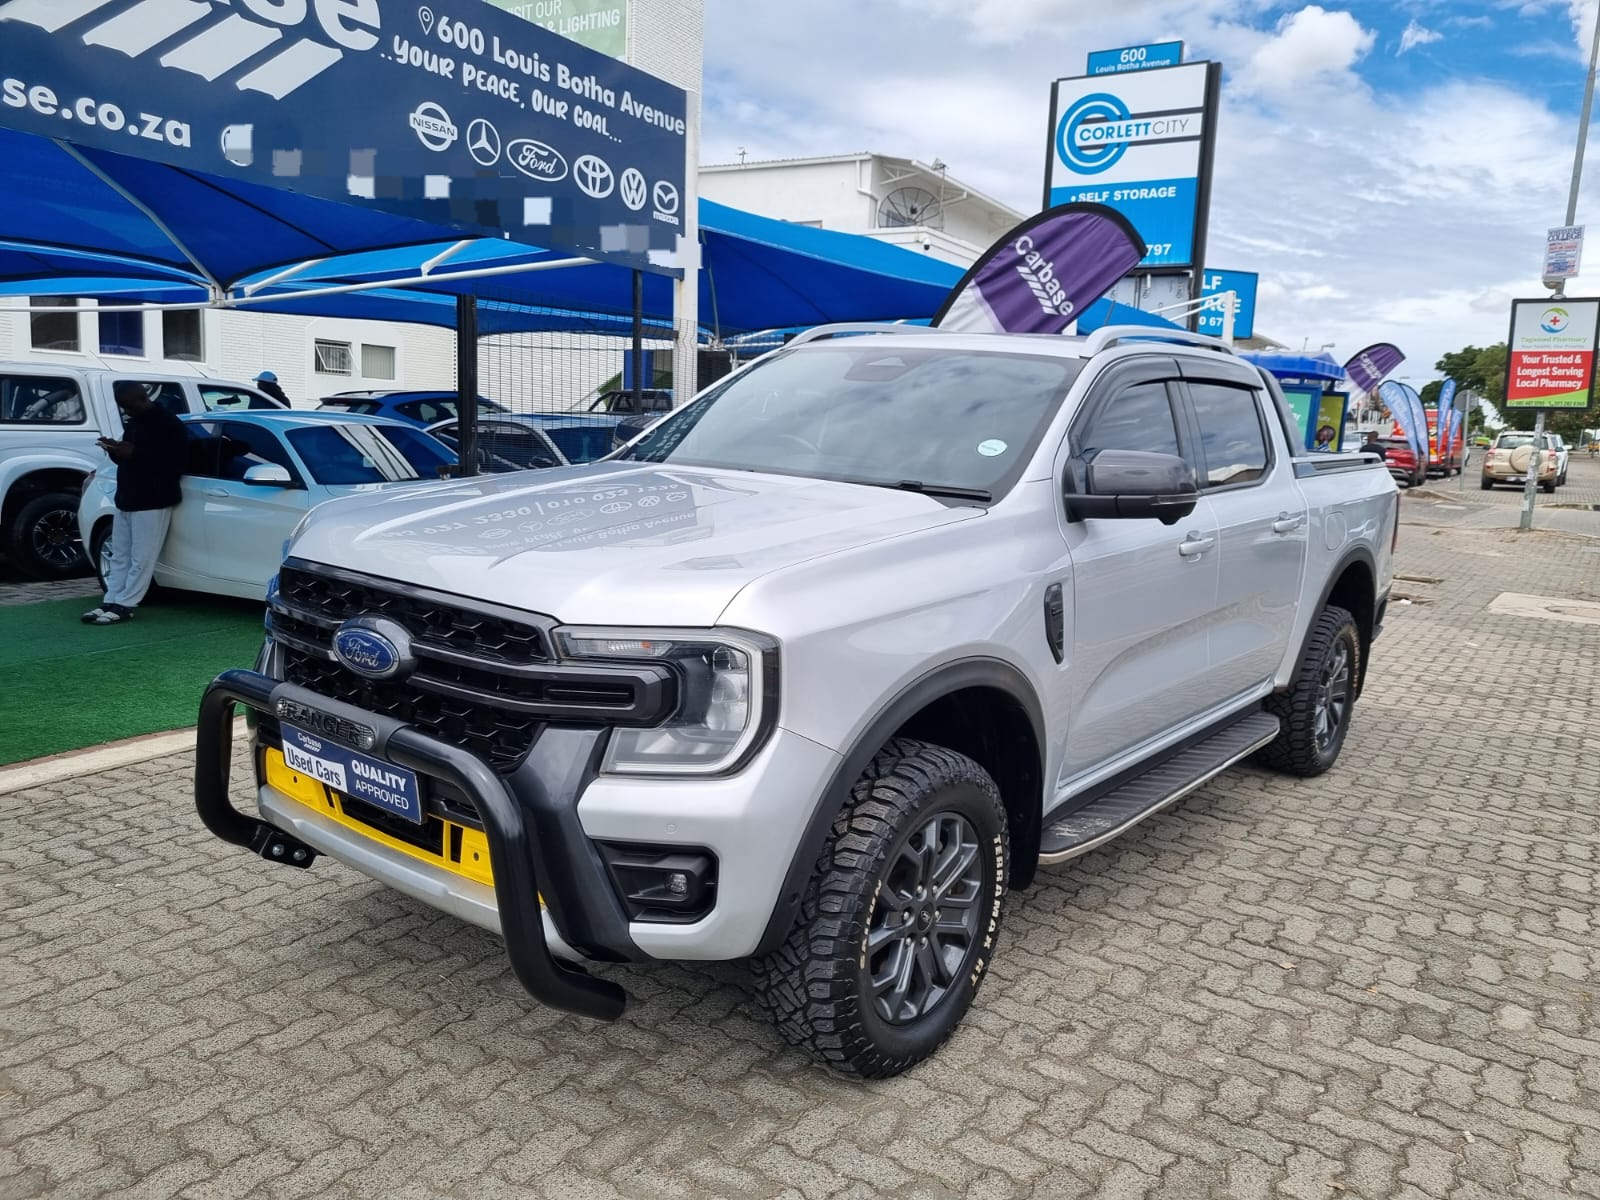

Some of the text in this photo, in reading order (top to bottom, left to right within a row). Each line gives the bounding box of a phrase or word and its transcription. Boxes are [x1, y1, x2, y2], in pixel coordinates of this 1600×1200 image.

[535, 0, 562, 18] OUR
[559, 8, 620, 34] LIGHTING
[1095, 59, 1171, 74] Louis Botha Avenue
[1120, 47, 1147, 63] 600
[437, 15, 685, 136] 600 Louis Botha Avenue
[2, 78, 192, 148] se.co.za
[532, 88, 568, 121] OUR
[413, 116, 455, 137] NISSAN
[518, 144, 558, 175] Ford
[1078, 186, 1177, 203] SELF STORAGE
[1015, 235, 1074, 316] Carbase
[1517, 366, 1584, 378] Longest Serving
[1521, 354, 1582, 364] Your Trusted &
[1516, 378, 1583, 390] Local Pharmacy
[345, 637, 381, 667] Ford
[287, 702, 360, 746] RANGER
[287, 747, 342, 786] Used Cars
[351, 759, 407, 792] QUALITY
[355, 779, 410, 810] APPROVED
[983, 833, 1004, 949] TERRAMAX
